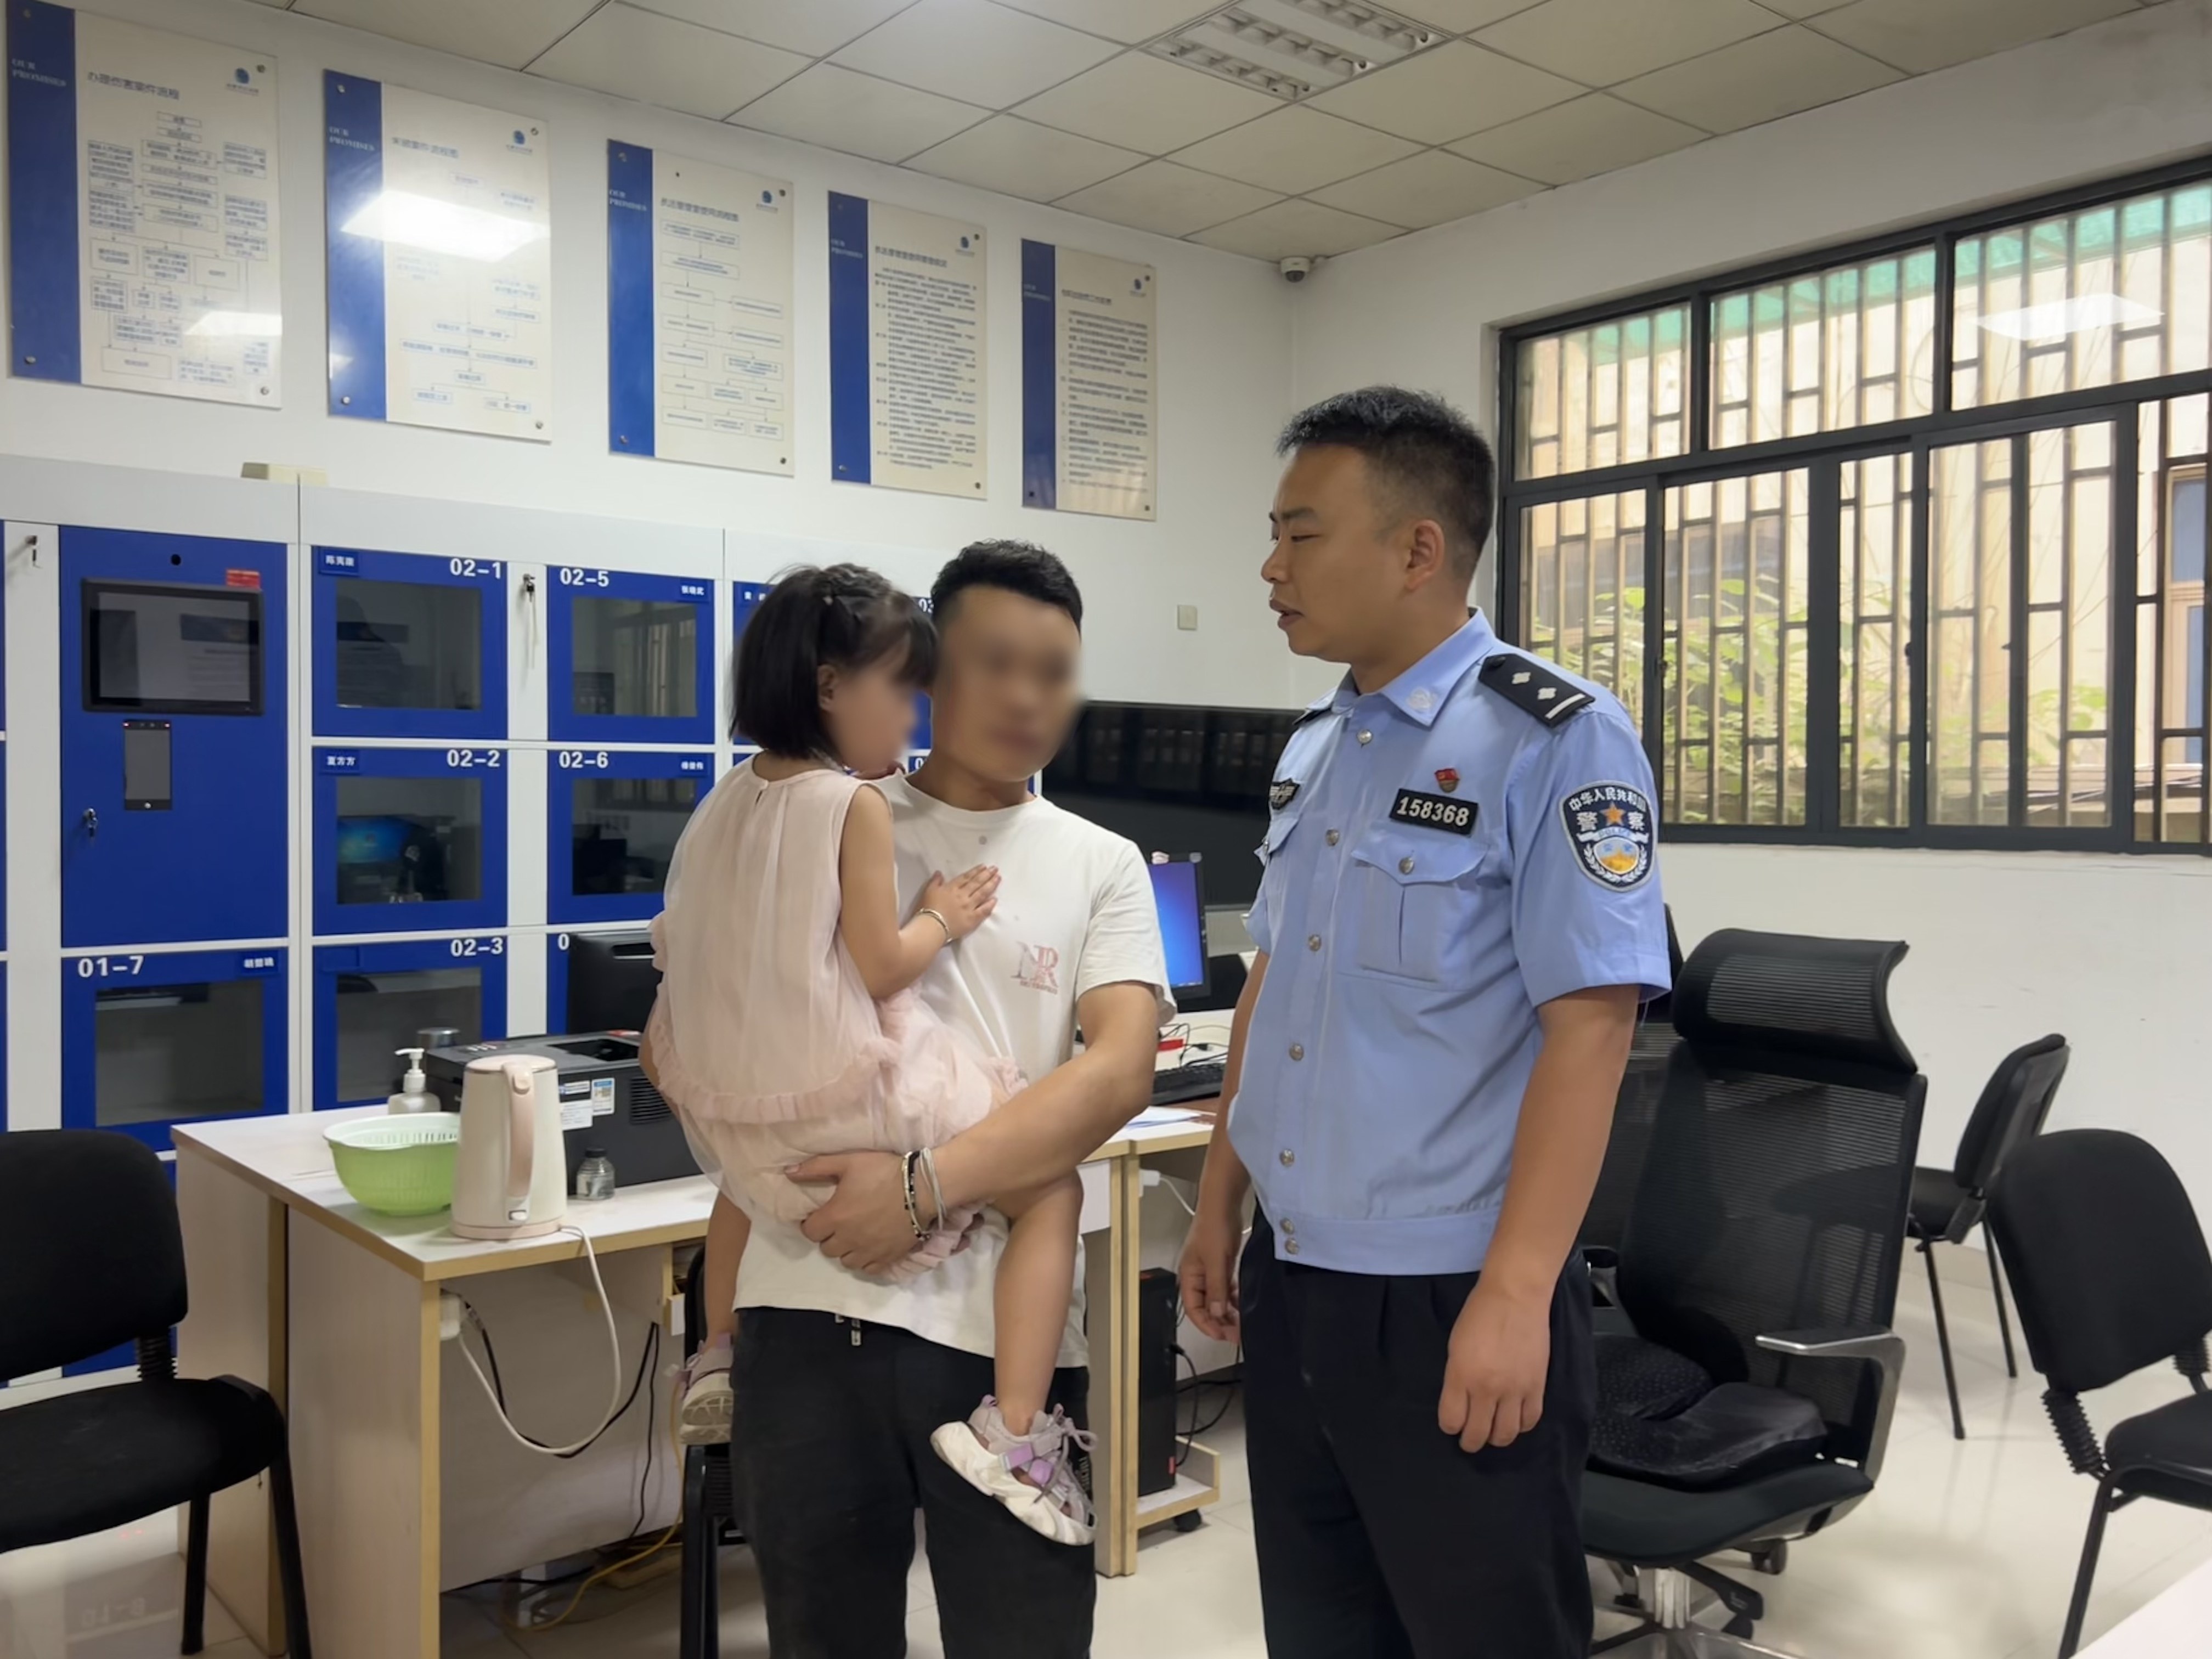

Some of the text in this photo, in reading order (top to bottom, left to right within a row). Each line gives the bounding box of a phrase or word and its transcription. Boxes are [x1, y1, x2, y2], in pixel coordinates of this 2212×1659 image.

[450, 557, 501, 579] 02-1
[560, 567, 609, 587] 02-5
[447, 749, 500, 767] 02-2
[559, 751, 608, 768] 02-6
[1568, 787, 1646, 812] 中华人民共和国
[1397, 797, 1470, 826] 158368
[450, 937, 503, 957] 02-3
[78, 955, 144, 978] 01-7
